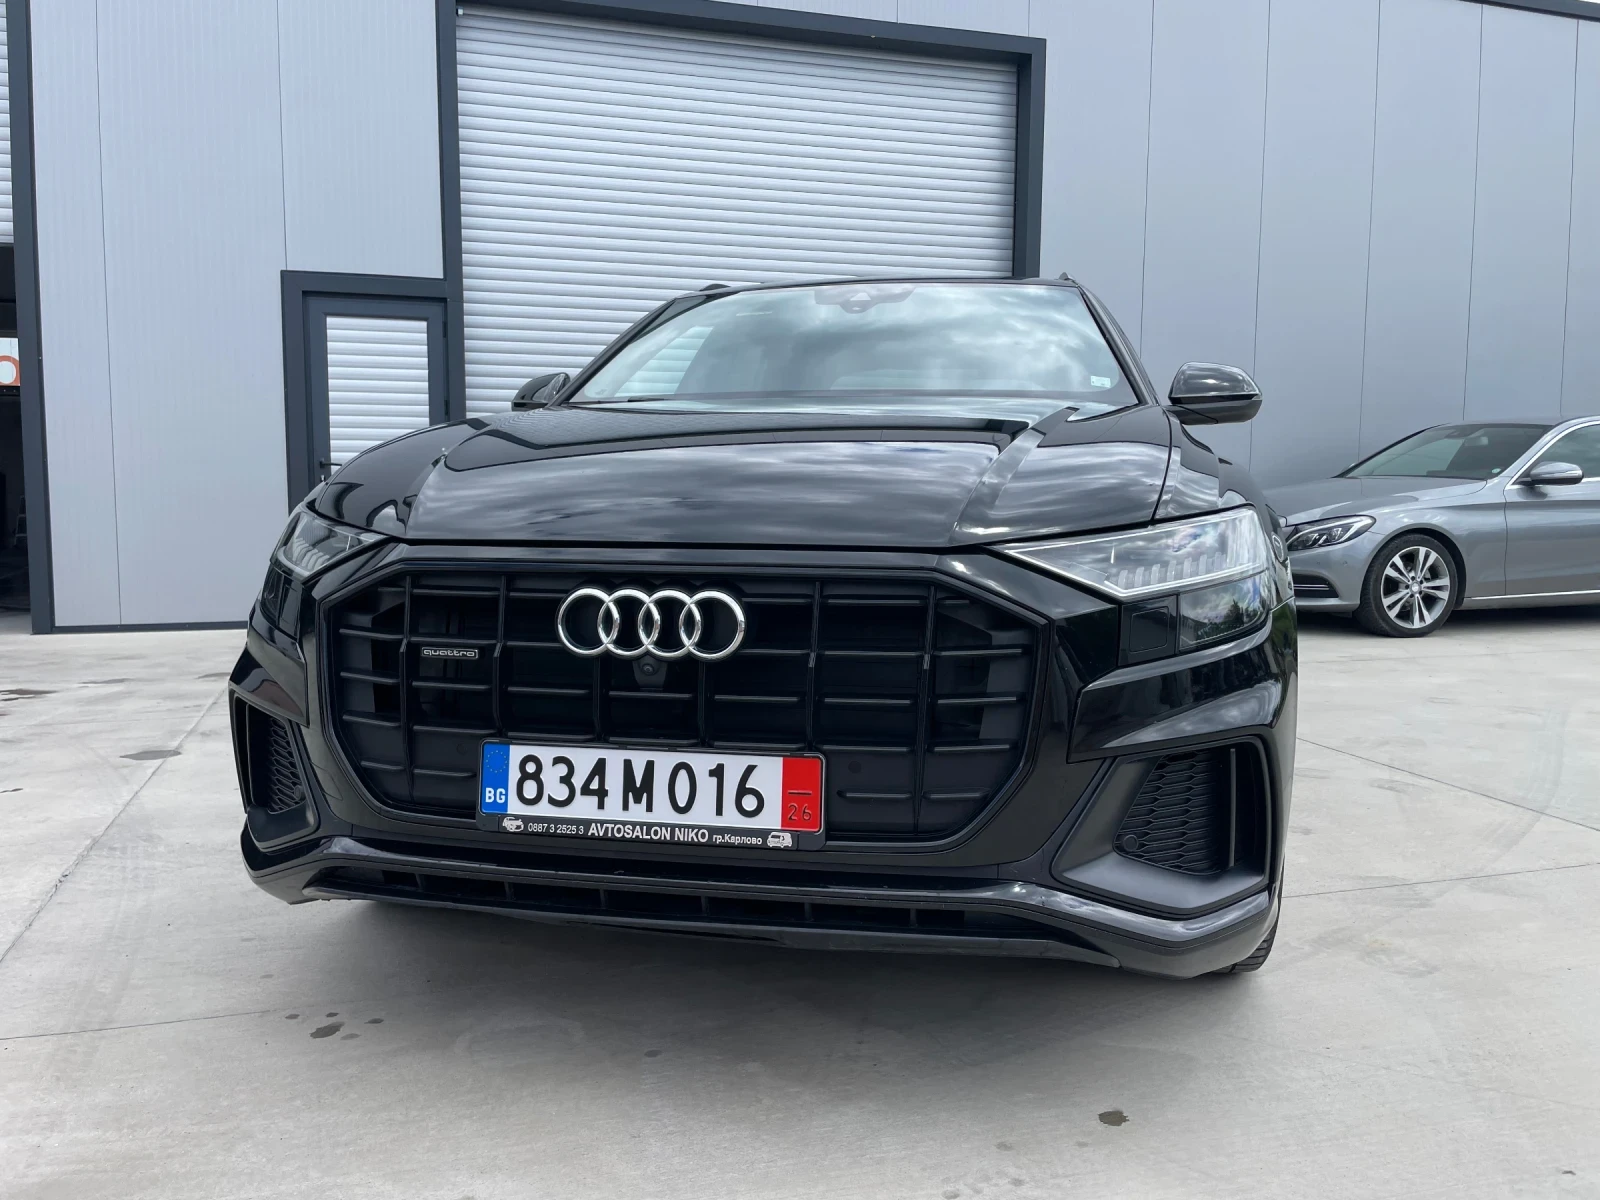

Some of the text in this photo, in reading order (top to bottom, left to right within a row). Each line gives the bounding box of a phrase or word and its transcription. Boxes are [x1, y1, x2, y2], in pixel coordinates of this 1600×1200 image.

[423, 649, 475, 657] quattro
[516, 754, 765, 818] 834 M 016
[485, 787, 506, 804] BG
[788, 803, 812, 821] 26
[527, 822, 547, 832] 0887
[550, 824, 555, 833] 3
[557, 824, 577, 834] 2525
[578, 825, 584, 835] 3
[587, 823, 671, 840] AVTOSALON
[674, 827, 709, 843] NIKO
